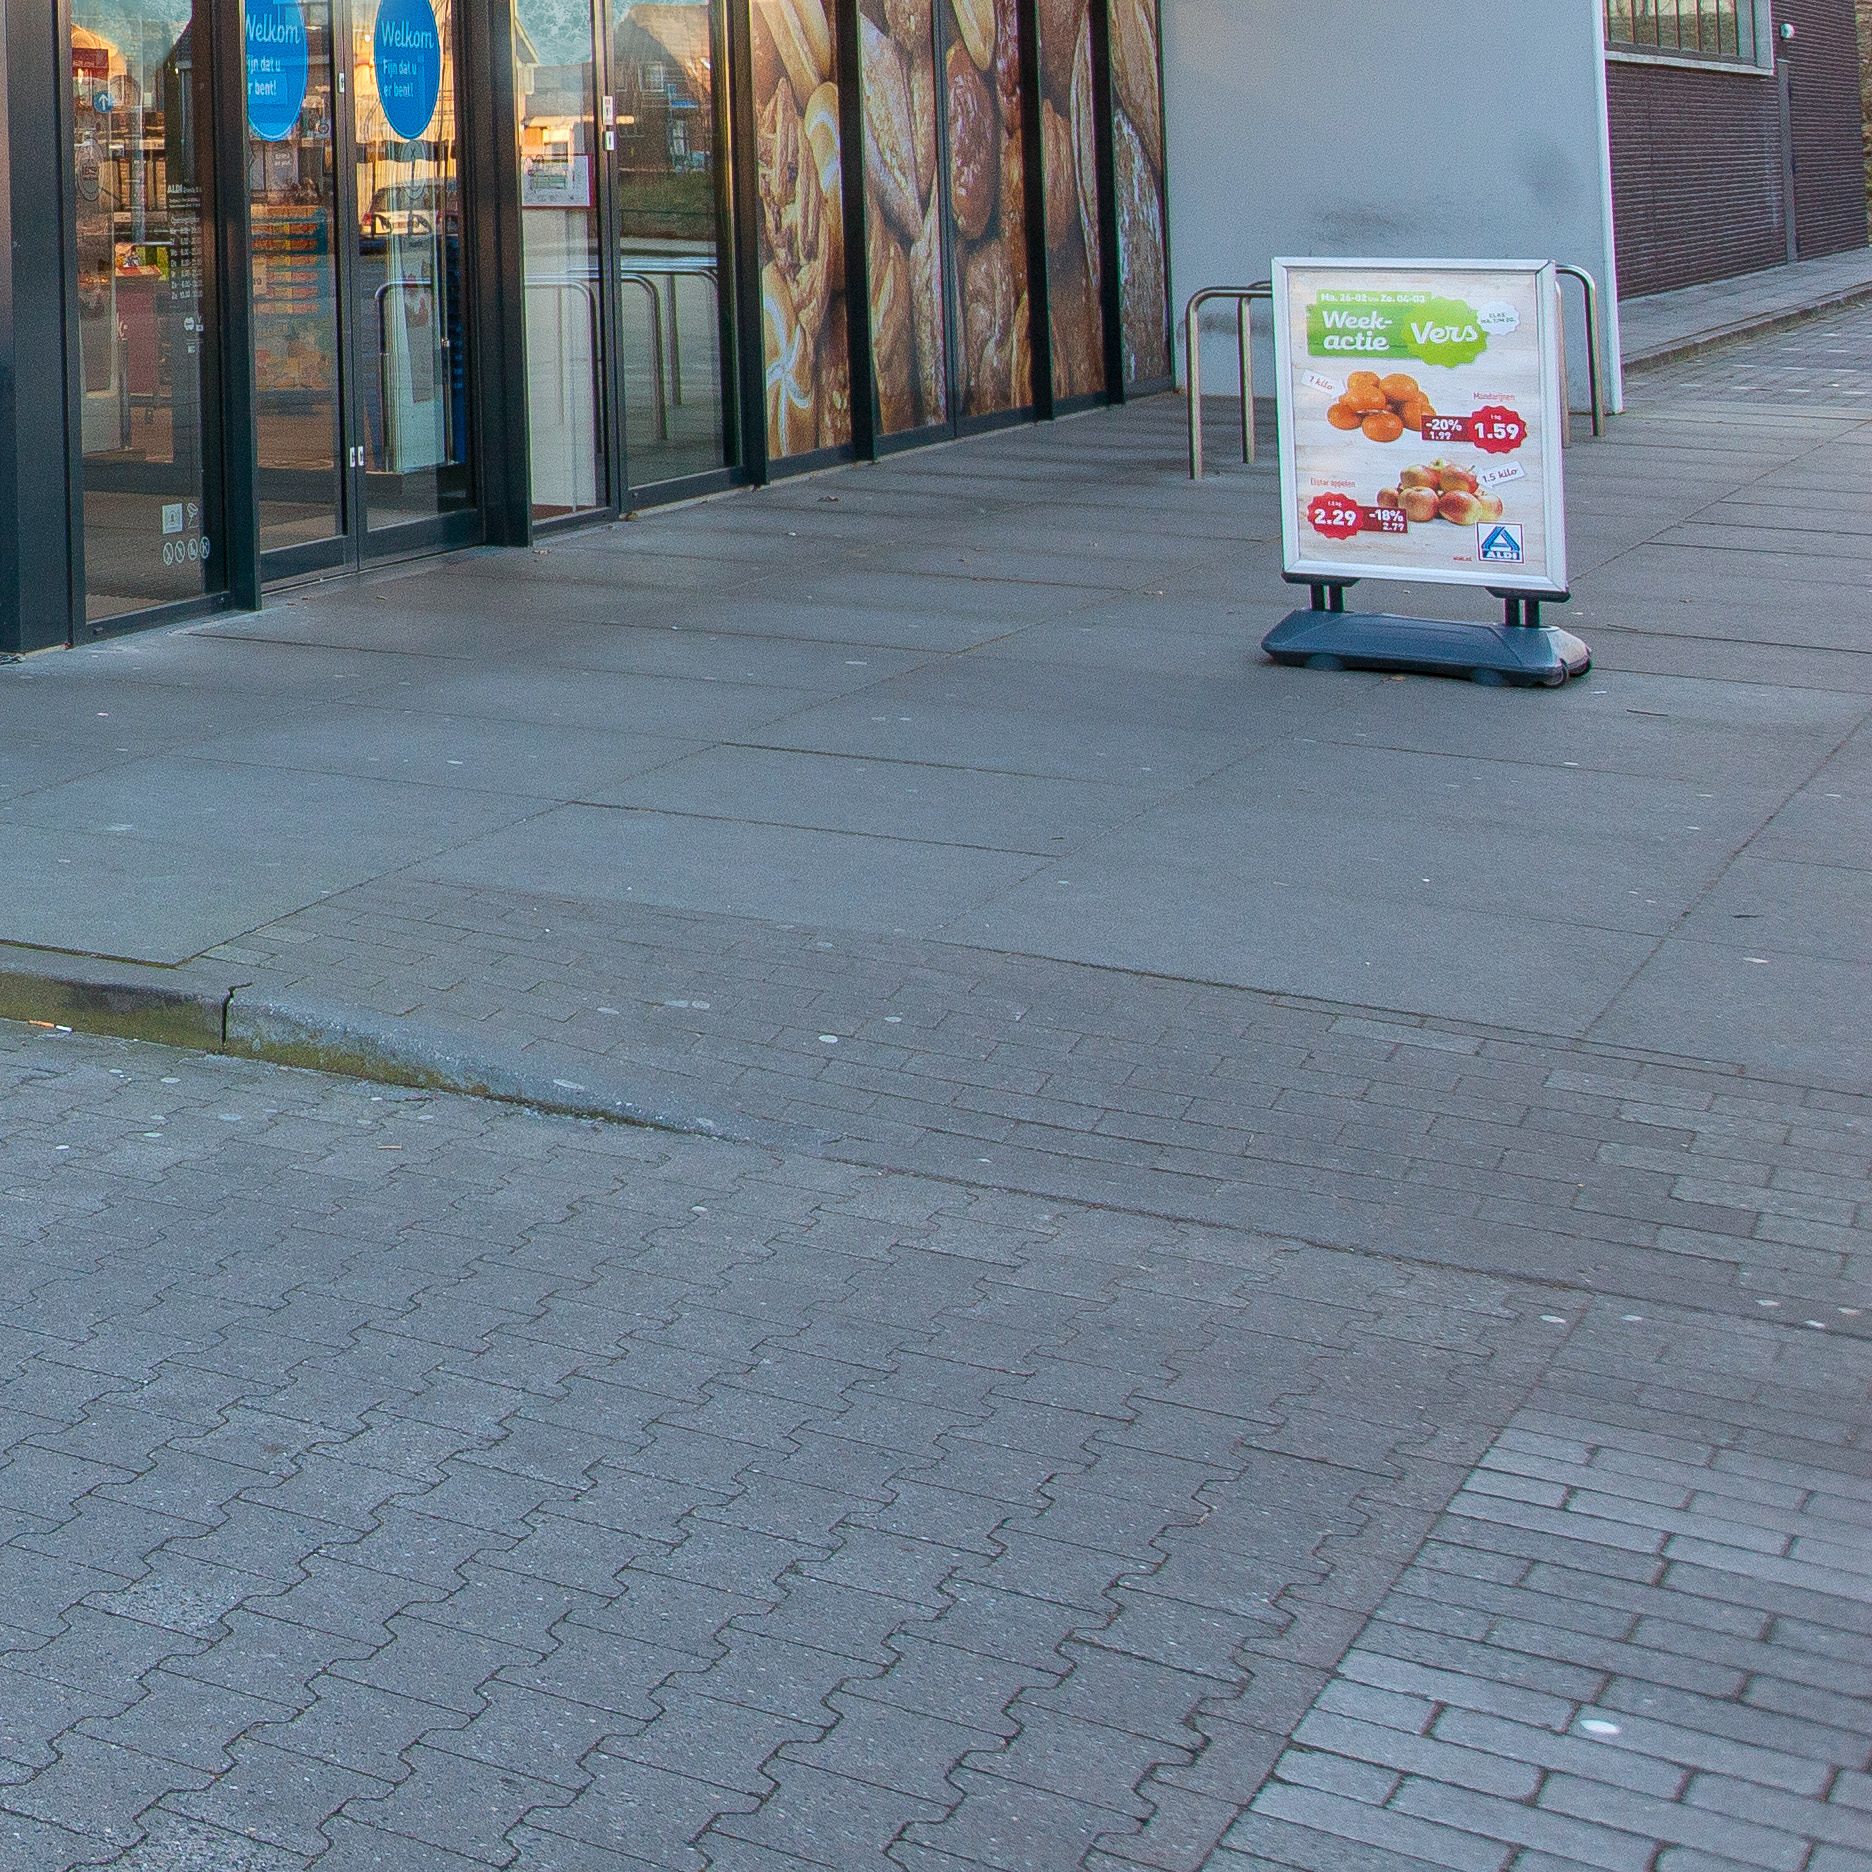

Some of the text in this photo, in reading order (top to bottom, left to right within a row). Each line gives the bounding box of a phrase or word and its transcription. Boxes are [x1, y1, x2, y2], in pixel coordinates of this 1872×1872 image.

[381, 20, 434, 49] Welkom
[261, 56, 274, 72] dat
[383, 59, 417, 77] Fijn dat u
[255, 79, 277, 96] bent!
[384, 82, 414, 98] er bent!
[1322, 309, 1393, 329] Week-
[1323, 330, 1390, 351] actie
[1410, 320, 1479, 345] Vers
[1316, 377, 1333, 390] kilo
[1425, 418, 1463, 432] -20%
[1474, 422, 1519, 440] 1.59
[1482, 467, 1518, 484] 1.5 kilo
[1314, 508, 1357, 527] 2.29
[1368, 508, 1404, 523] -18%
[1485, 551, 1519, 561] ALDI
